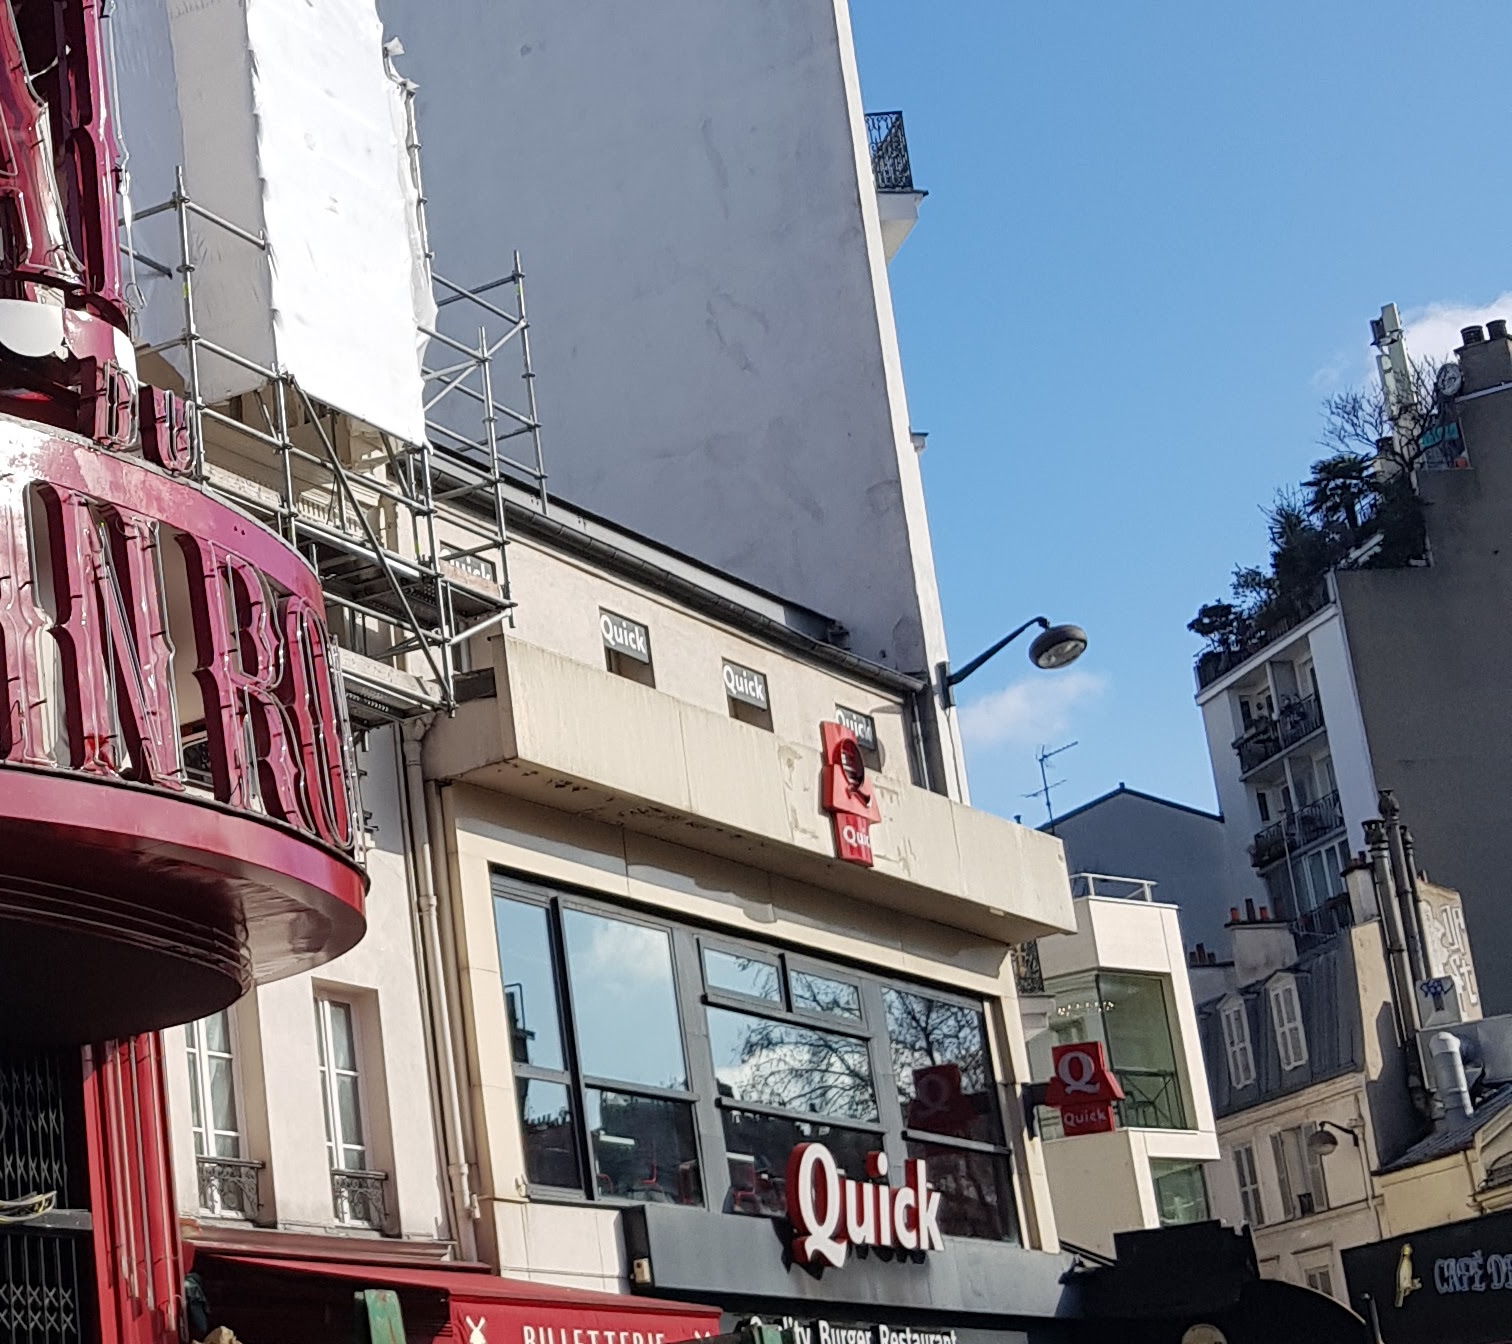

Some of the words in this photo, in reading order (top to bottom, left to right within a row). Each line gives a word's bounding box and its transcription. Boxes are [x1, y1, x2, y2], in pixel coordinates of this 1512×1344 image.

[600, 614, 648, 655] Quick
[179, 532, 368, 852] RO
[723, 664, 766, 702] Quick
[843, 825, 871, 847] Quic
[1058, 1050, 1101, 1094] Q
[1063, 1108, 1108, 1126] Quick
[791, 1142, 944, 1268] Quick
